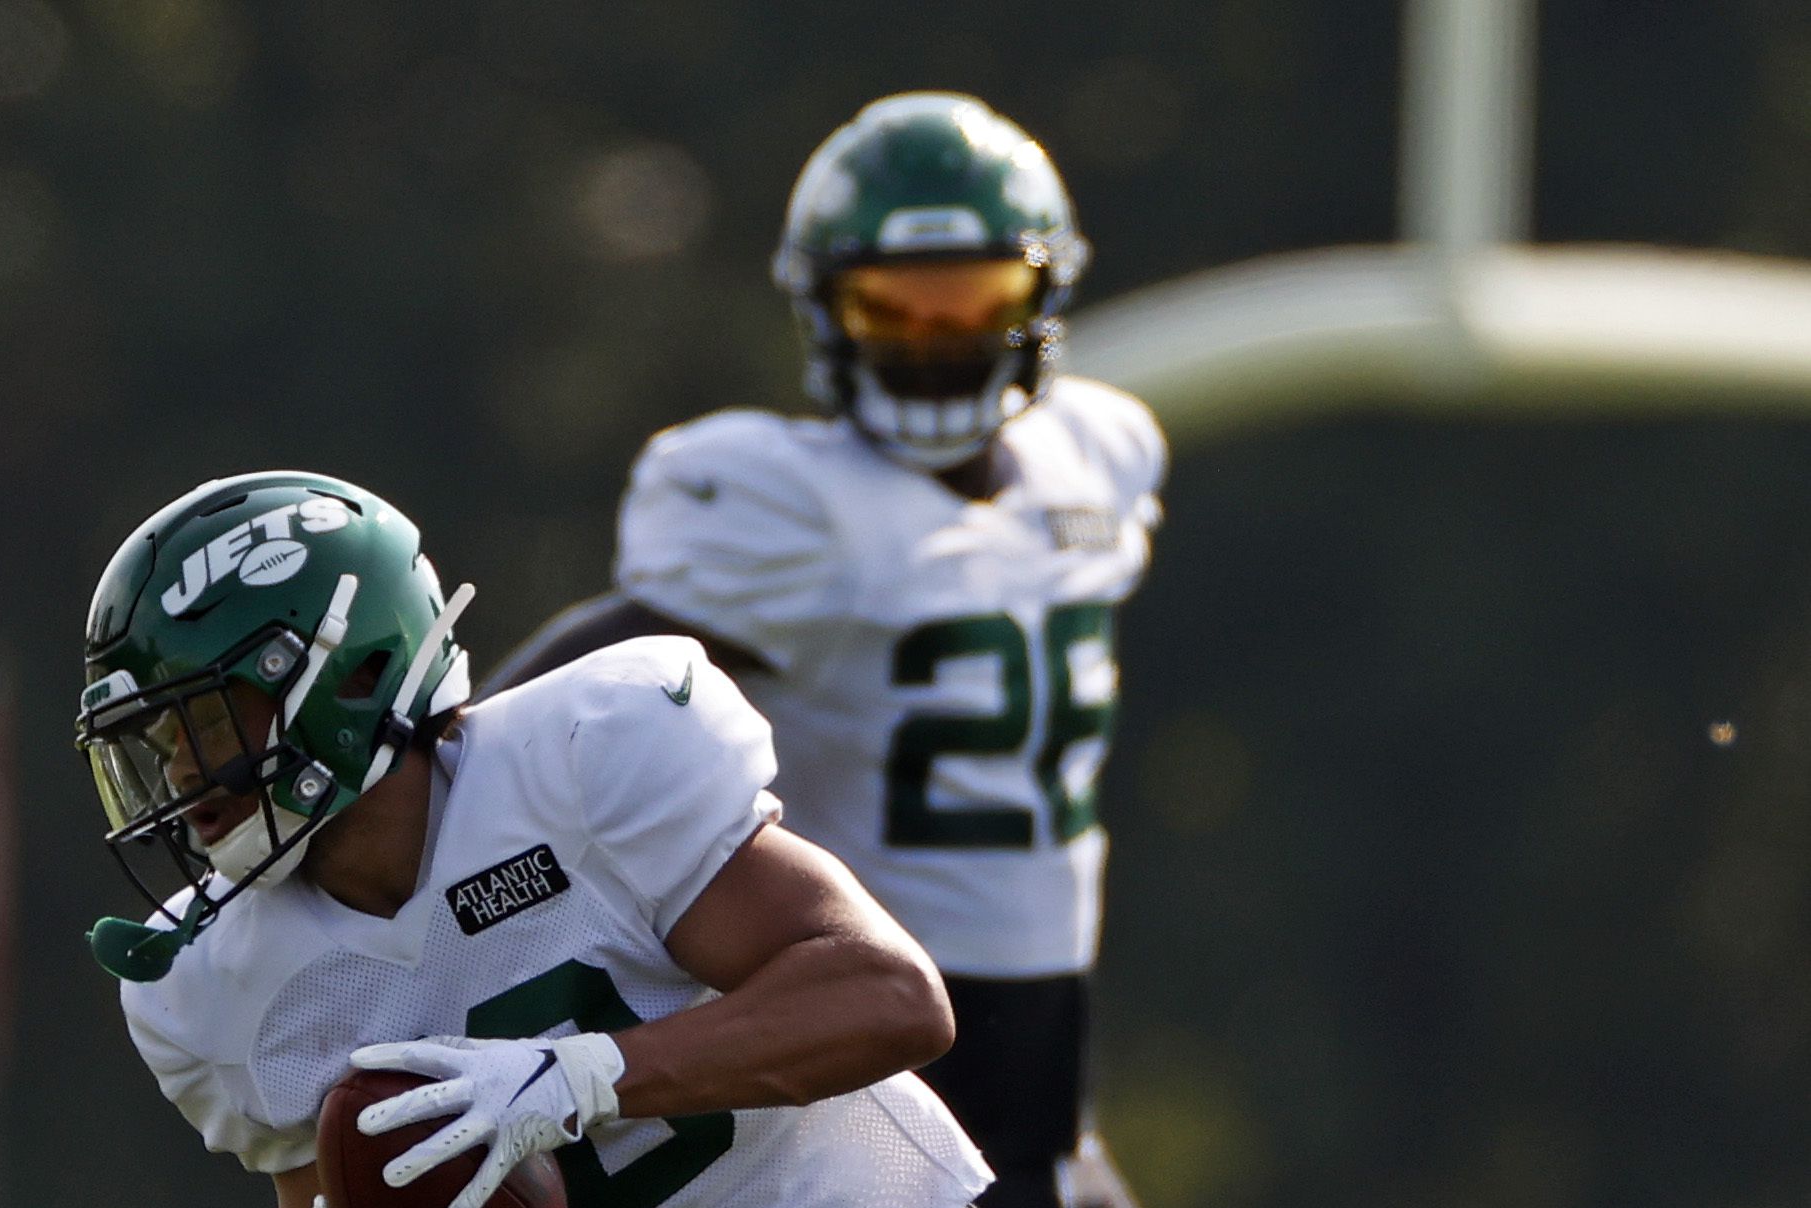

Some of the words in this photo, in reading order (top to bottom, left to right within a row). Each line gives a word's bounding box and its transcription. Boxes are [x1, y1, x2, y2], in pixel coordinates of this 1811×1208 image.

[161, 496, 350, 617] JETS
[455, 849, 552, 913] ATLANTIC
[471, 872, 552, 925] HEALTH
